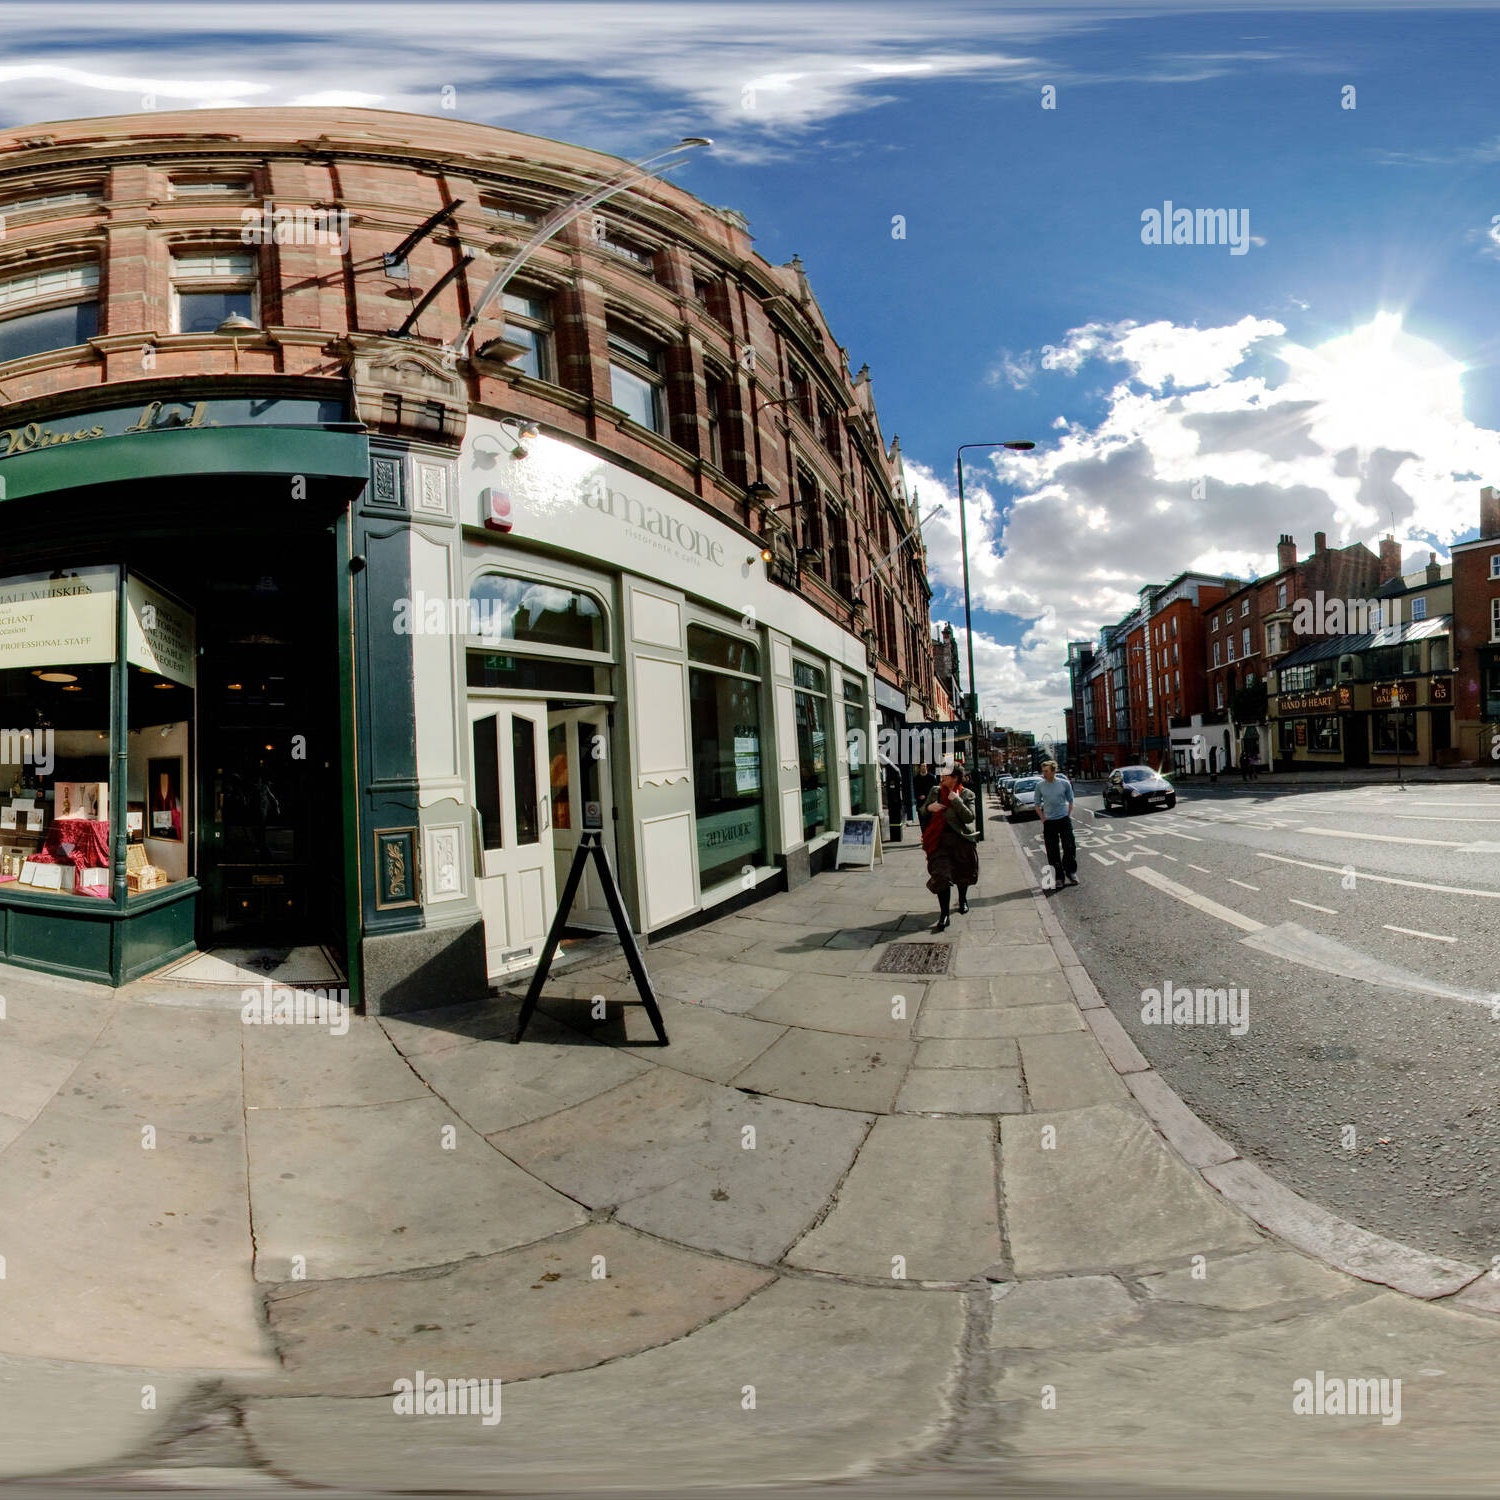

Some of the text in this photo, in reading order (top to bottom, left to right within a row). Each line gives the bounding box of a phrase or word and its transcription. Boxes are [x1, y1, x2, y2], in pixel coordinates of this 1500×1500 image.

[580, 477, 725, 569] amarone
[625, 527, 673, 555] ristorante
[31, 585, 93, 600] WHISKIES
[0, 639, 62, 651] PROFESSIONAL
[64, 636, 92, 646] STAFF
[154, 652, 185, 673] REQUEST
[1434, 688, 1446, 699] 65
[1281, 696, 1333, 711] HAND & HEART
